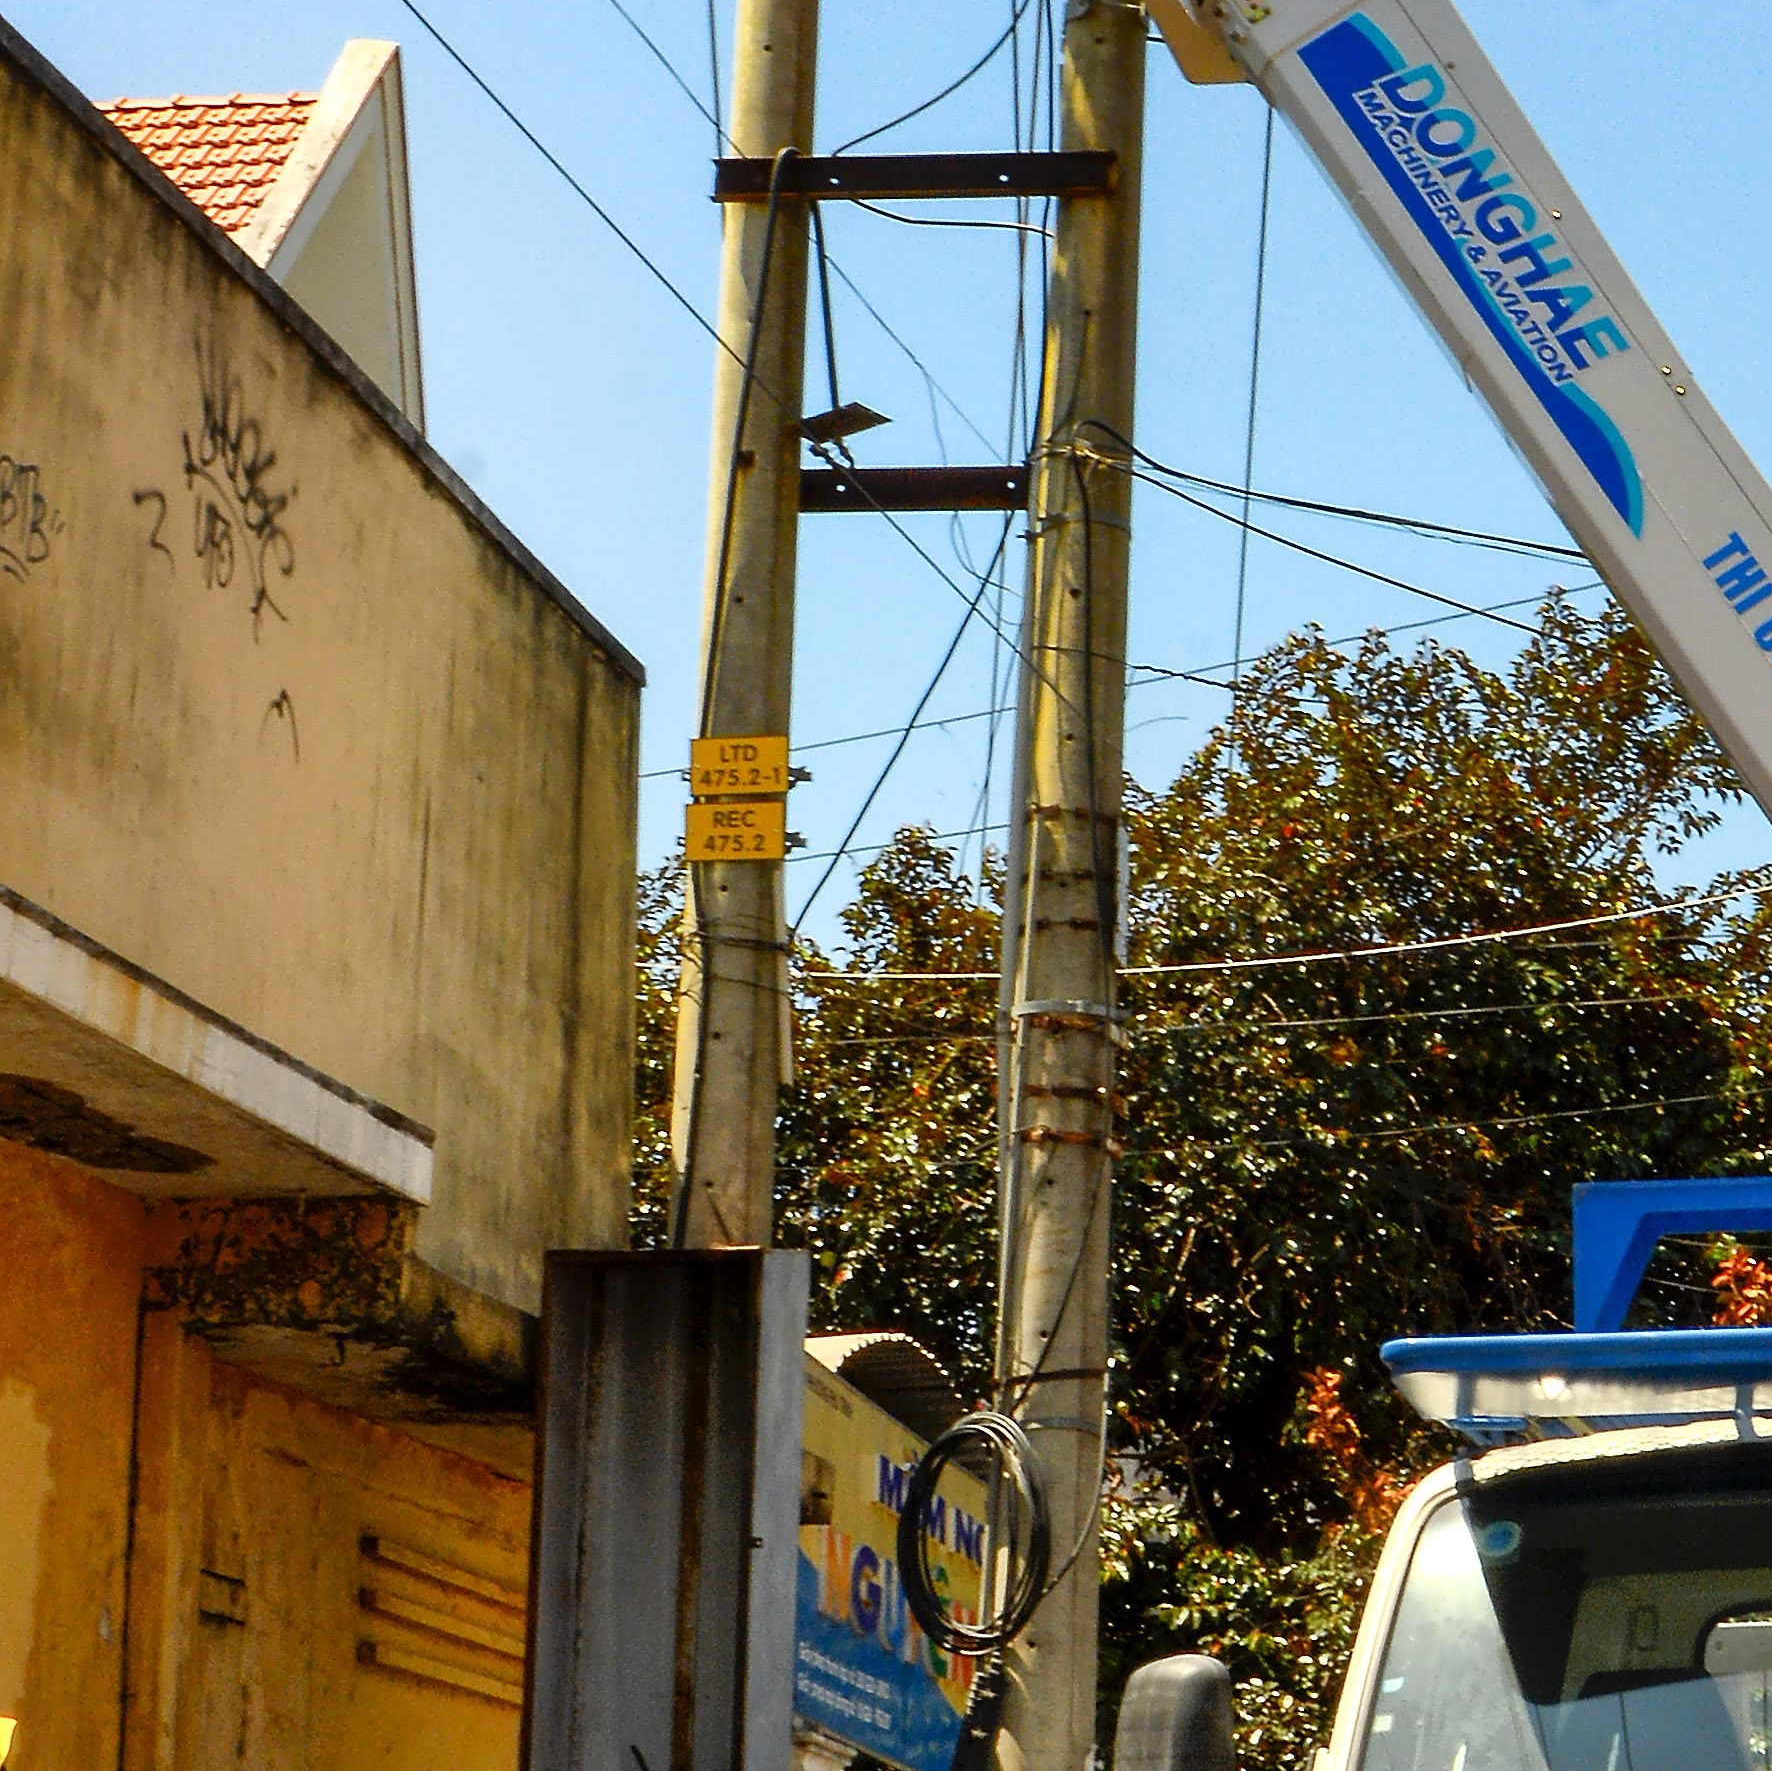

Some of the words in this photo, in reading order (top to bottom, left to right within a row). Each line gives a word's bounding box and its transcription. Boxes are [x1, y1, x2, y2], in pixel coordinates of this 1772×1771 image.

[1376, 63, 1630, 371] DONGHAE
[1356, 91, 1475, 240] MACHINERY
[1467, 245, 1488, 265] &
[1481, 266, 1574, 384] AVIATION
[719, 744, 759, 763] LTD
[700, 767, 782, 787] 475.2-1
[713, 811, 756, 829] REC
[703, 834, 766, 853] 475.2
